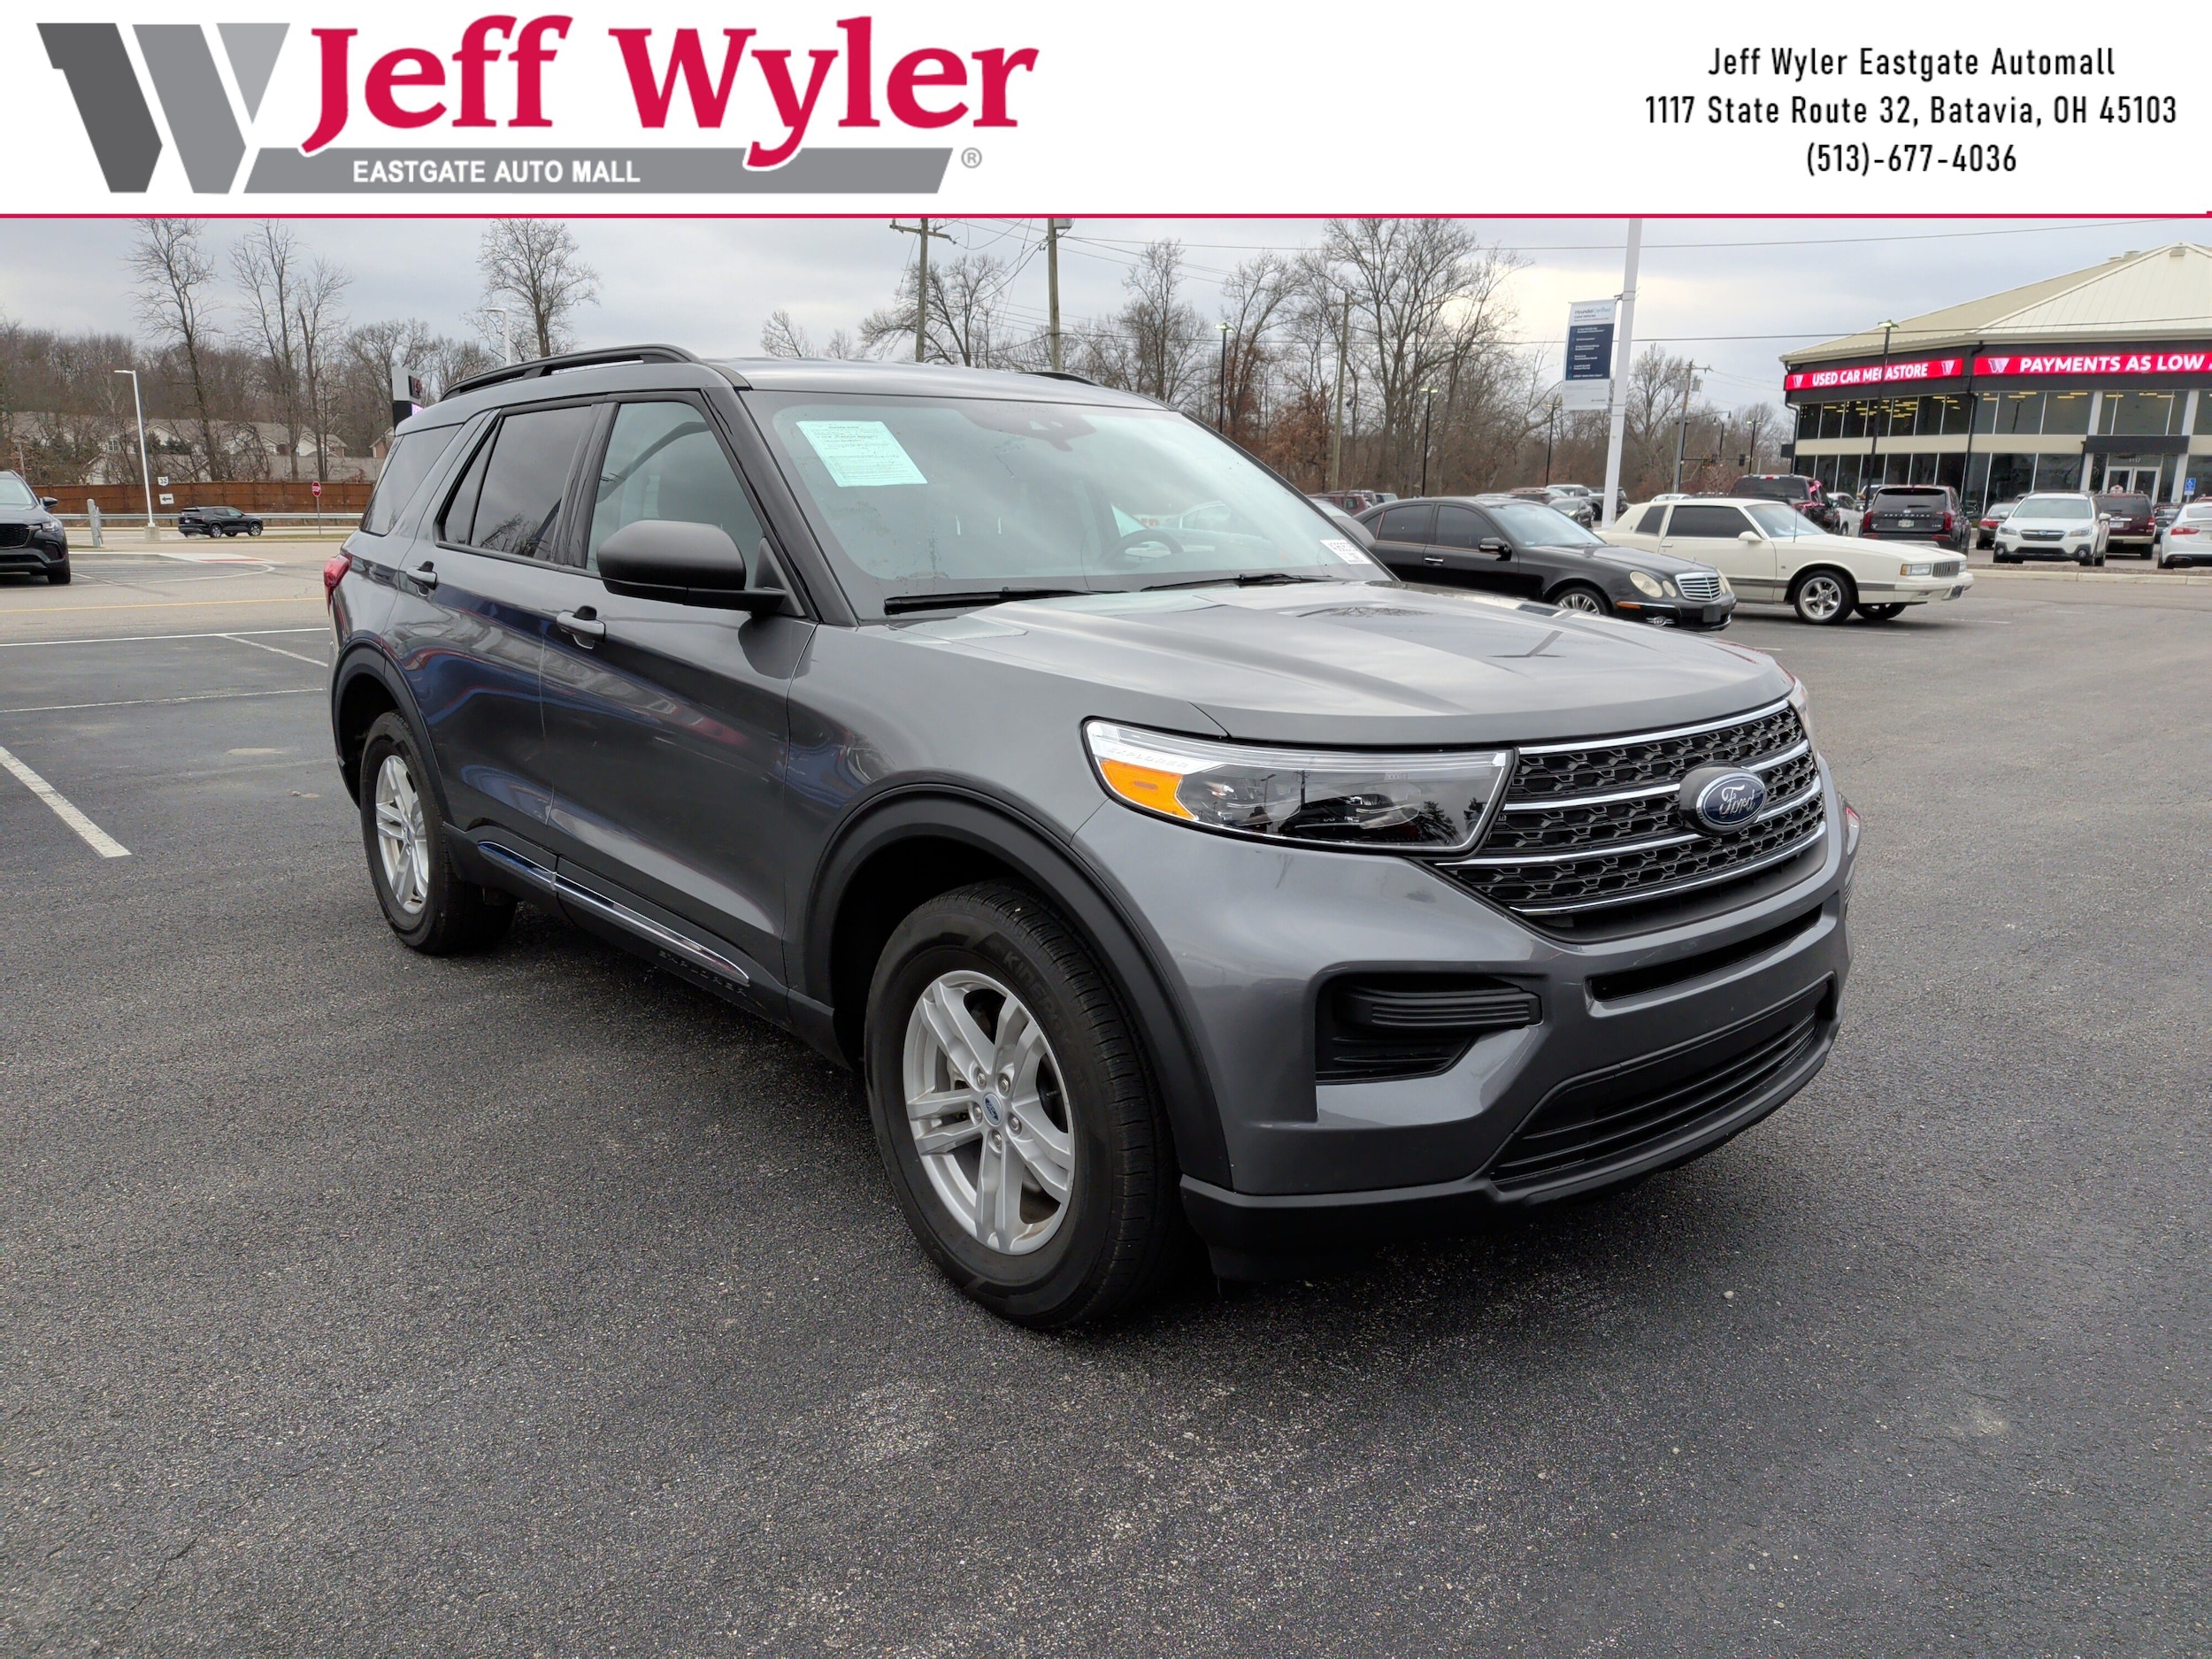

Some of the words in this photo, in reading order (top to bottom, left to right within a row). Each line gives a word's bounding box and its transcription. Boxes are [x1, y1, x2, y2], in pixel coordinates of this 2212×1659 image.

[2019, 357, 2121, 373] PAYMENTS
[2125, 356, 2152, 371] AS
[2156, 355, 2205, 371] LOW
[1812, 372, 1839, 387] USED
[1839, 370, 1860, 385] CAR
[1719, 785, 1755, 818] Ford
